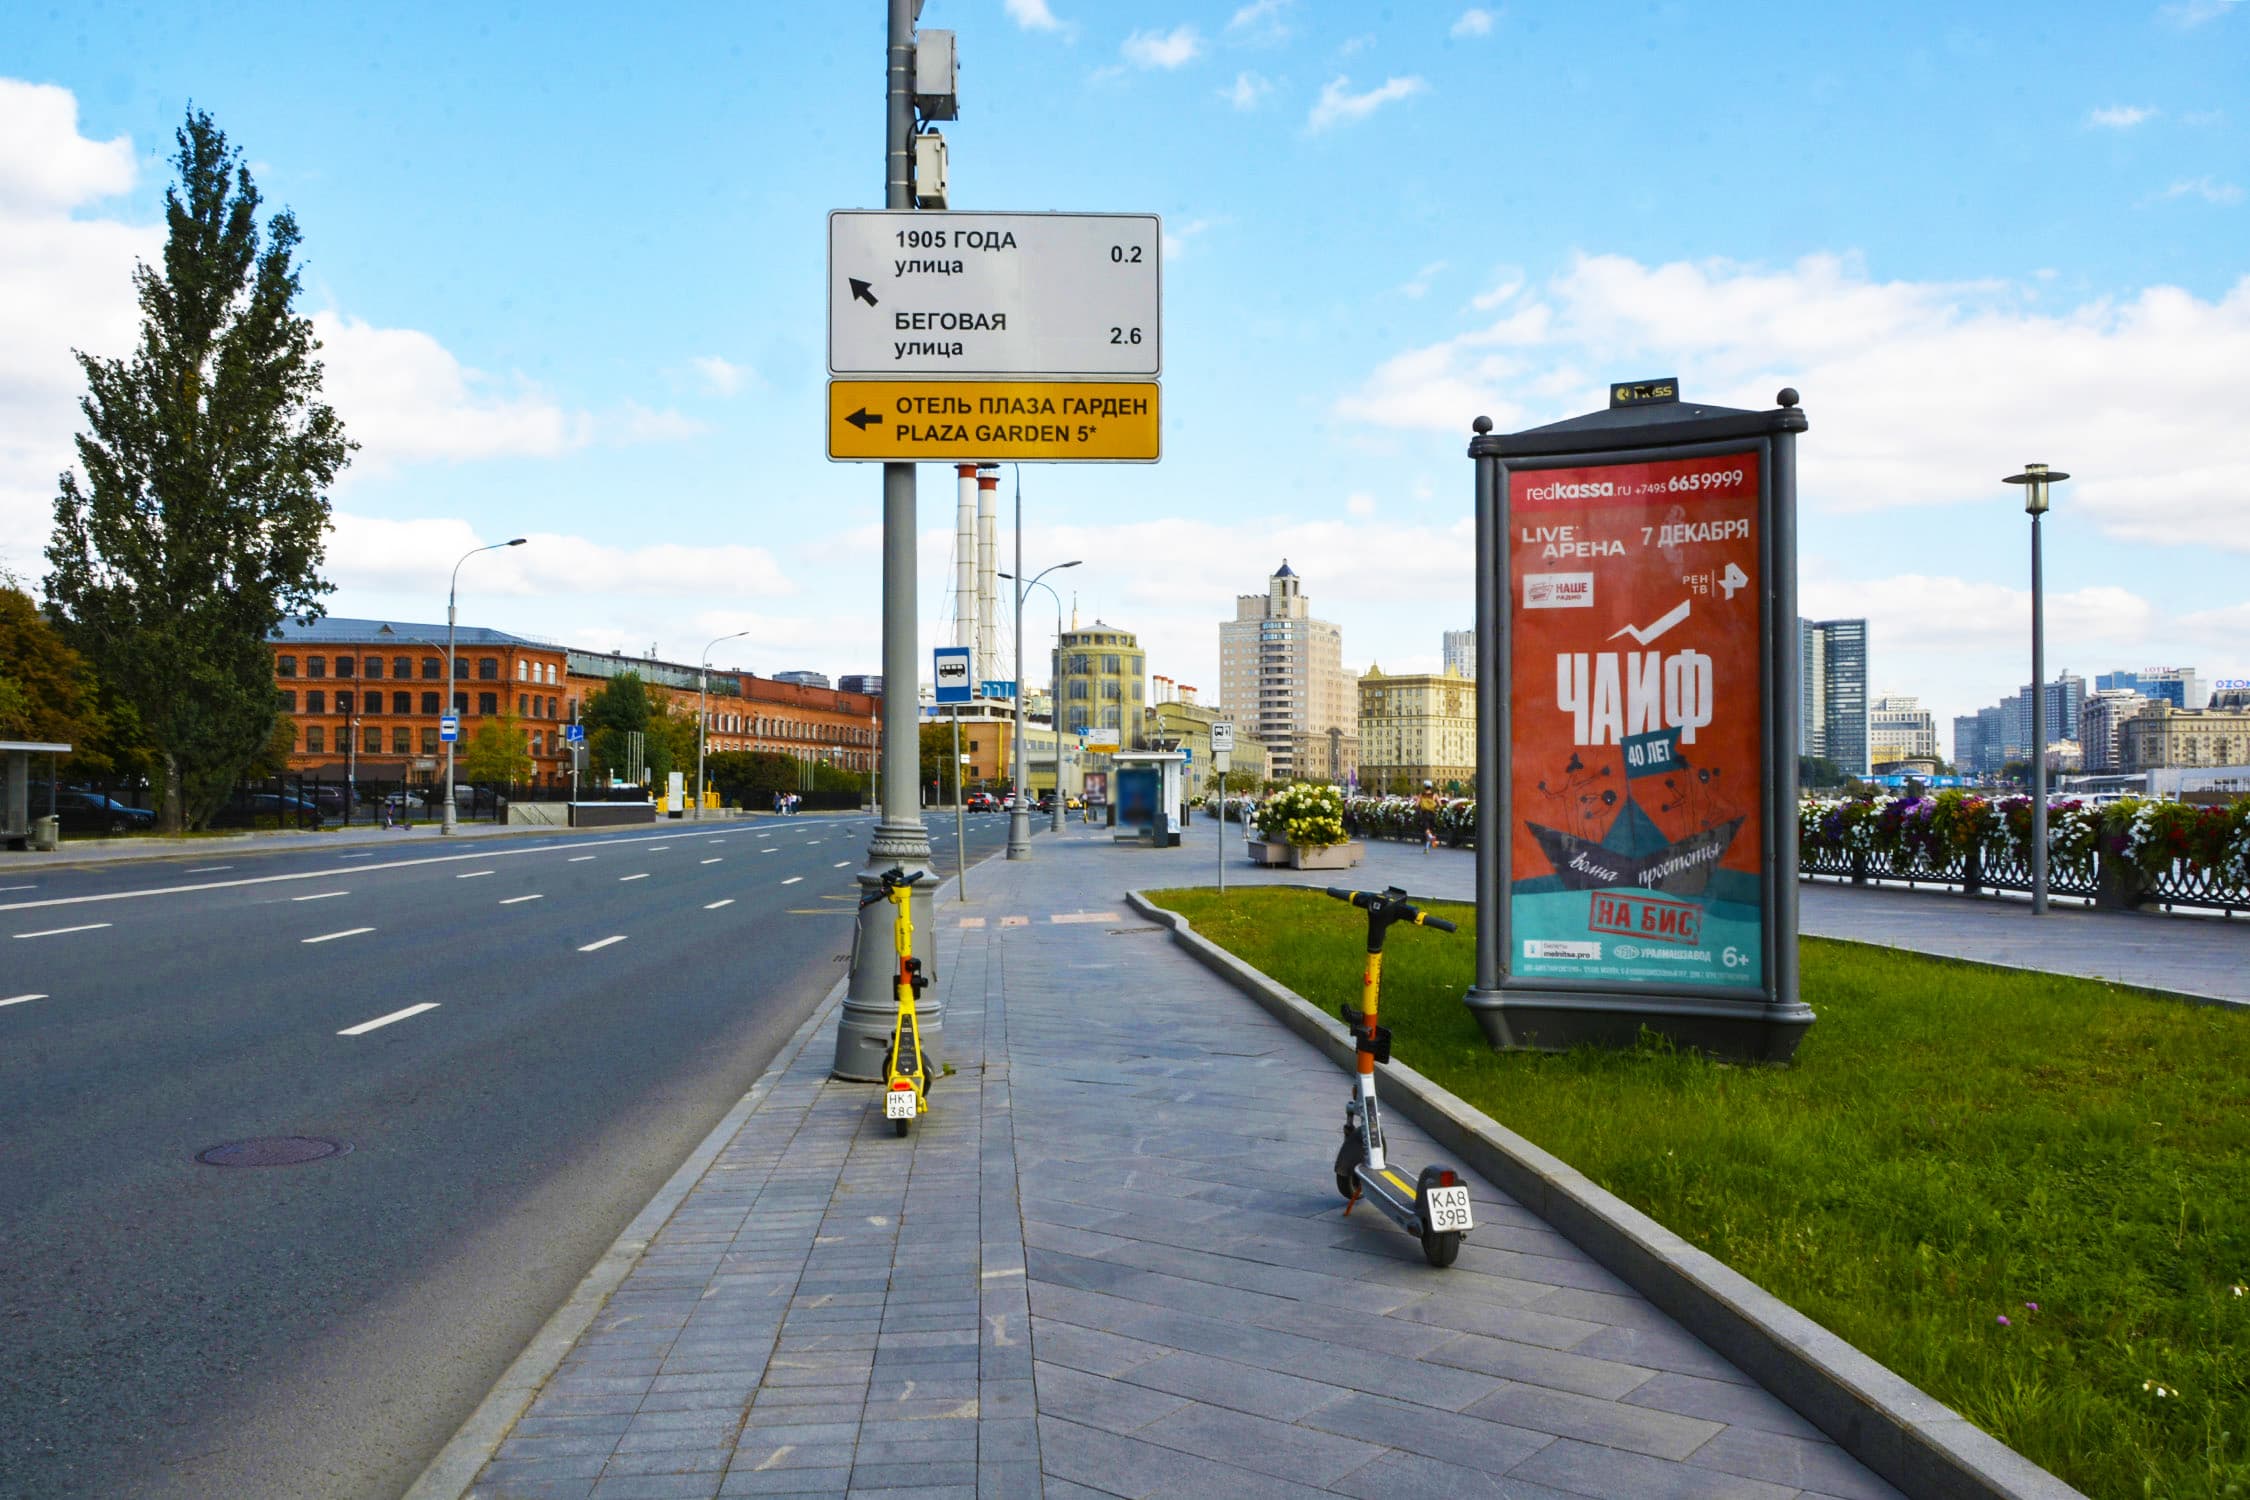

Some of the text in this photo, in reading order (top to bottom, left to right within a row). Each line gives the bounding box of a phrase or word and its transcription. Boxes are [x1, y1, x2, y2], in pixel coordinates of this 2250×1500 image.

[895, 231, 1017, 252] 1905 ГОДА
[1110, 246, 1143, 263] 0.2
[894, 257, 964, 277] улица
[895, 312, 1007, 331] БЕГОВАЯ
[1110, 327, 1142, 345] 2.6
[894, 340, 964, 359] улица
[895, 397, 1148, 419] ОТЕЛЬ ПЛАЗА ГАРДЕН
[896, 425, 970, 442] PLAZA
[975, 424, 1070, 443] GARDEN
[1526, 481, 1631, 501] redkassa.ru
[1521, 525, 1575, 543] LIVE
[1641, 518, 1750, 549] 7 ДЕКАБРЯ
[1542, 540, 1627, 560] АРЕНА
[1555, 582, 1588, 594] НАШЕ
[1682, 574, 1709, 585] РЕН
[1691, 585, 1708, 595] ТВ
[1628, 738, 1672, 767] 40 ЛЕТ
[1568, 842, 1723, 890] волна простоты
[1597, 899, 1695, 938] НА БИС
[1721, 945, 1750, 968] 6+
